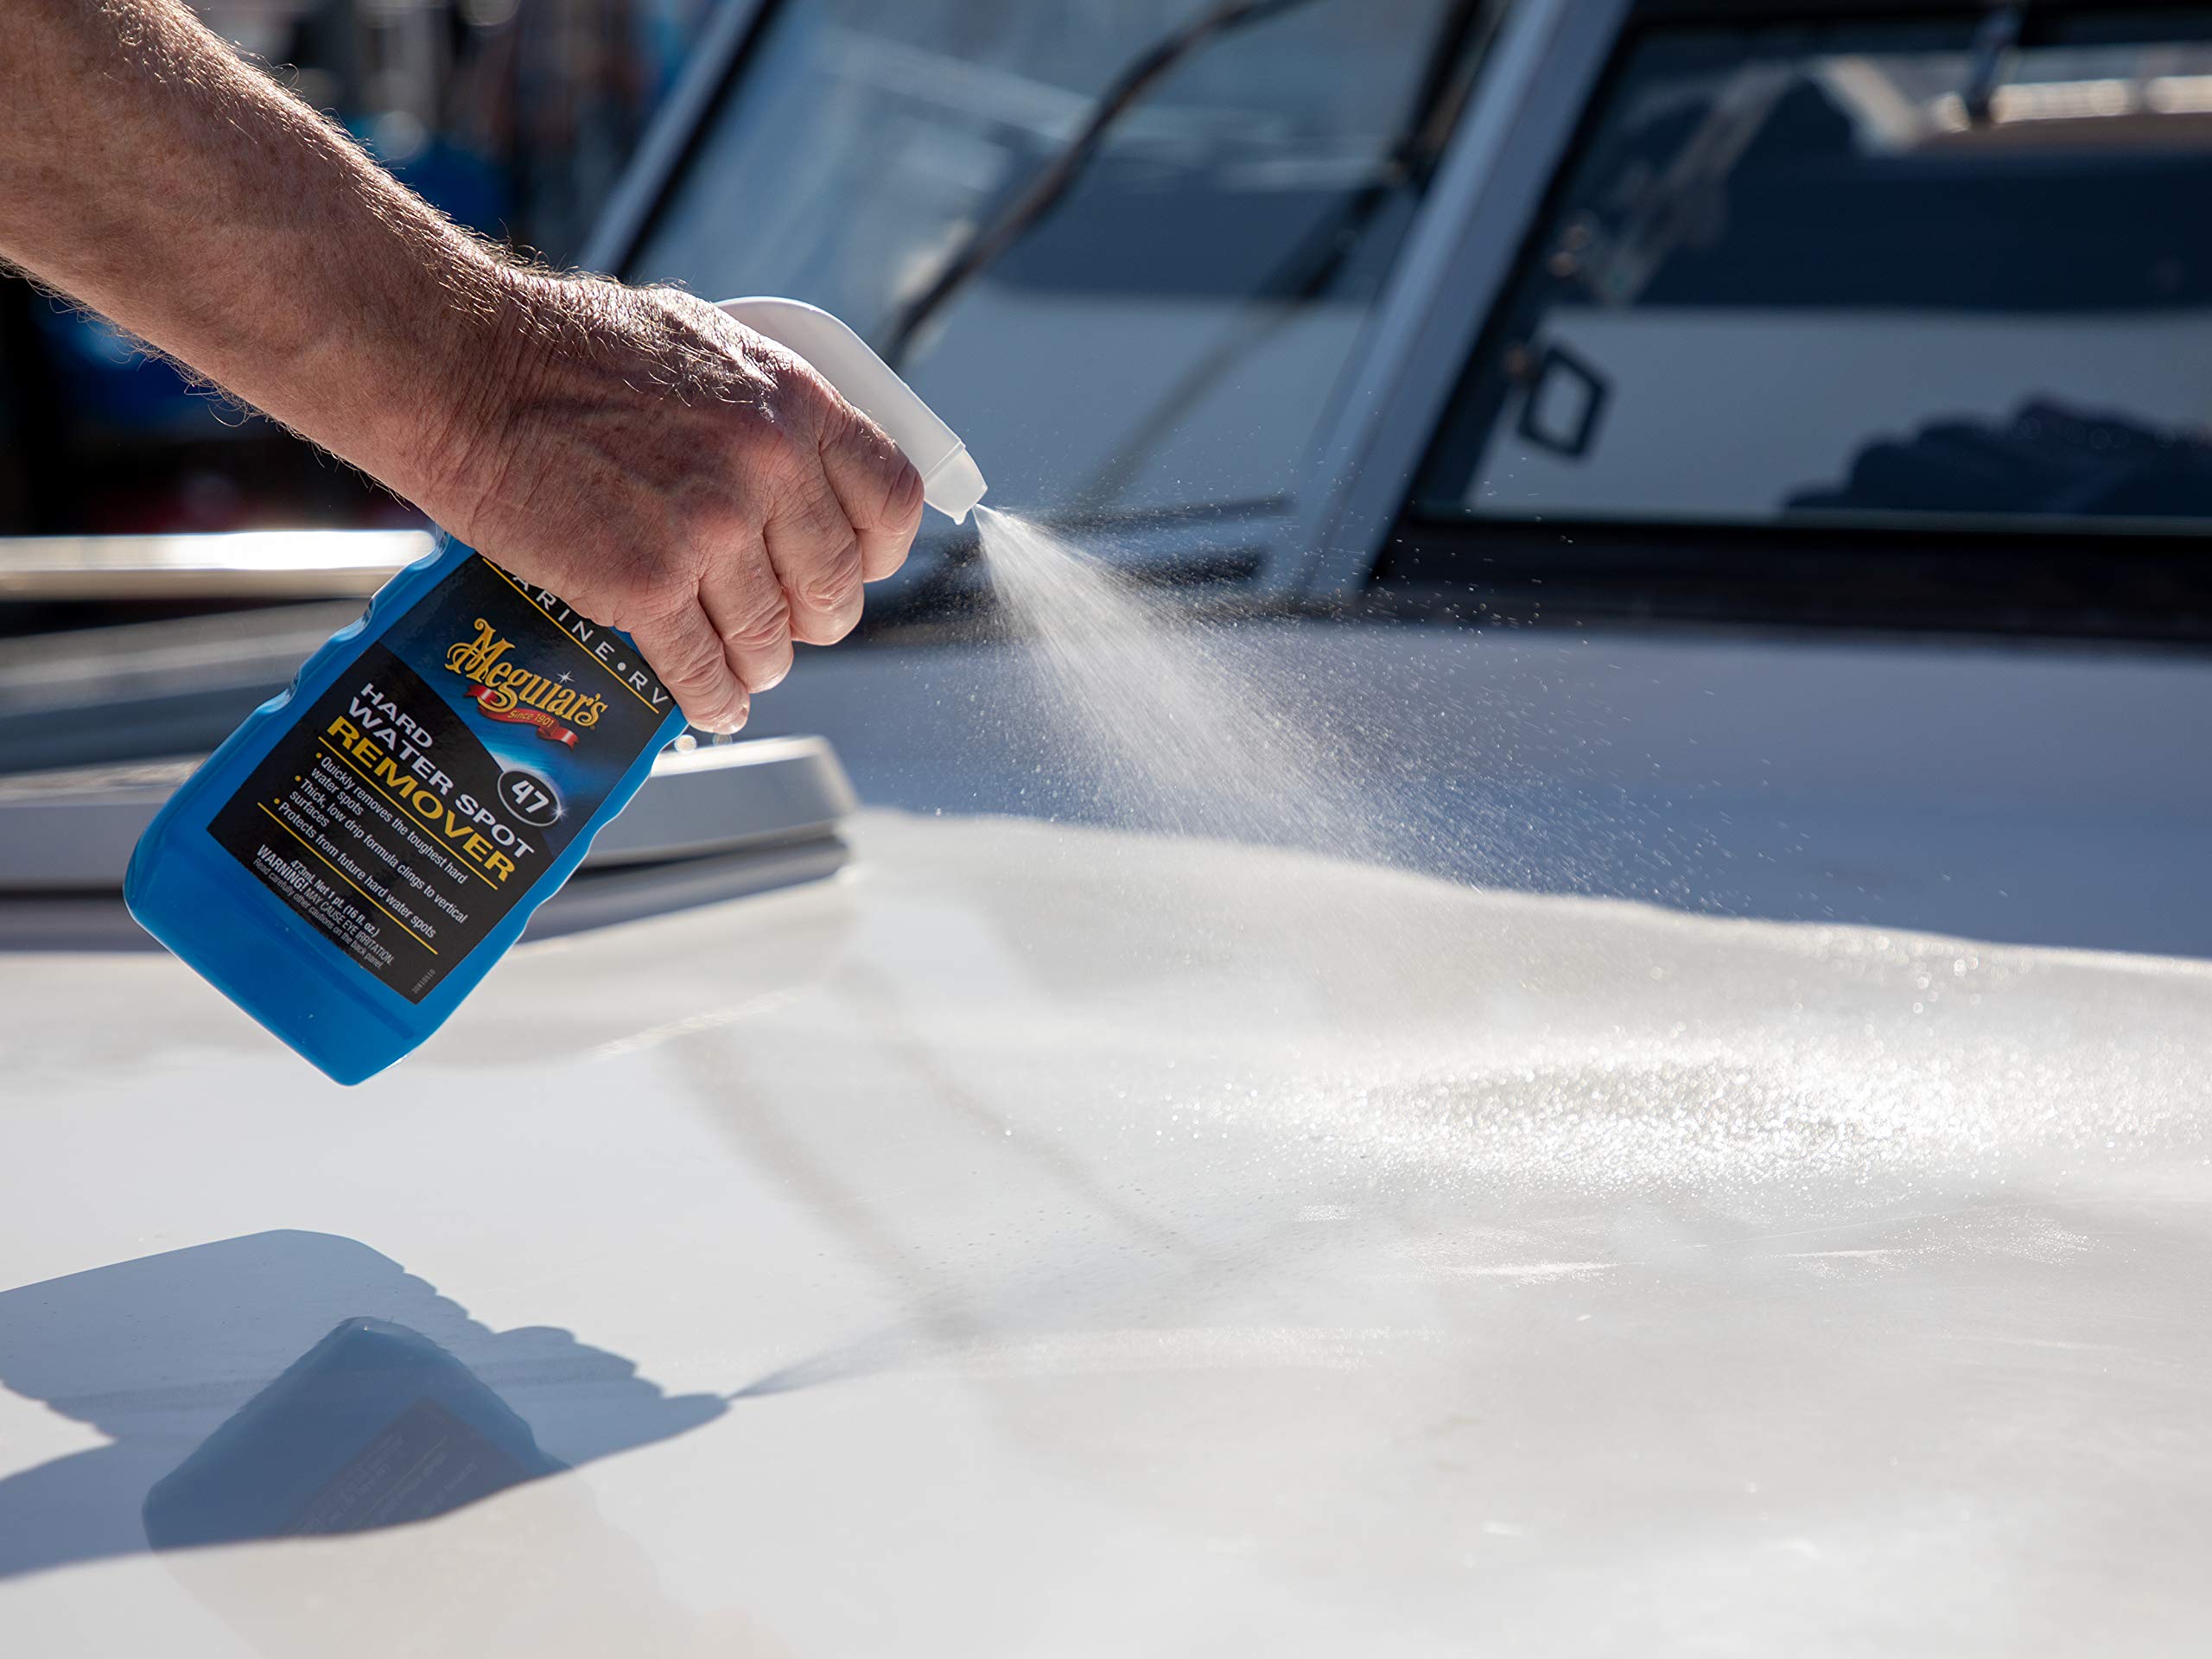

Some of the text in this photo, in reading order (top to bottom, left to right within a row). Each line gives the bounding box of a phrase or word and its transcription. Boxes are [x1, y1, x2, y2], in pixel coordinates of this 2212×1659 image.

[444, 618, 607, 727] Meguiar's
[499, 565, 668, 704] ARINE RV
[361, 683, 433, 748] HARD
[507, 710, 554, 728] Since 1901
[289, 791, 330, 827] surfaces
[311, 768, 364, 816] water spots
[321, 756, 468, 884] Quickly removes the toughest hard
[327, 715, 515, 882] REMOVER
[348, 696, 535, 858] WATER SPOT
[512, 780, 550, 813] 47
[257, 844, 308, 892] WARNING!
[304, 887, 323, 905] MAY
[320, 901, 346, 925] CAUSE
[342, 919, 359, 936] EYE
[278, 801, 436, 938] Protects from future hard water spots
[290, 860, 315, 883] 473mL
[314, 879, 331, 895] Net
[331, 896, 344, 909] pt.
[343, 905, 359, 917] (16
[300, 779, 468, 924] Thick, low drip formula clings to vertical
[253, 858, 271, 874] Read
[269, 872, 296, 897] carefully
[293, 893, 310, 908] other
[308, 905, 334, 929] cautions
[333, 925, 342, 936] on
[341, 931, 354, 944] the
[351, 939, 366, 956] back
